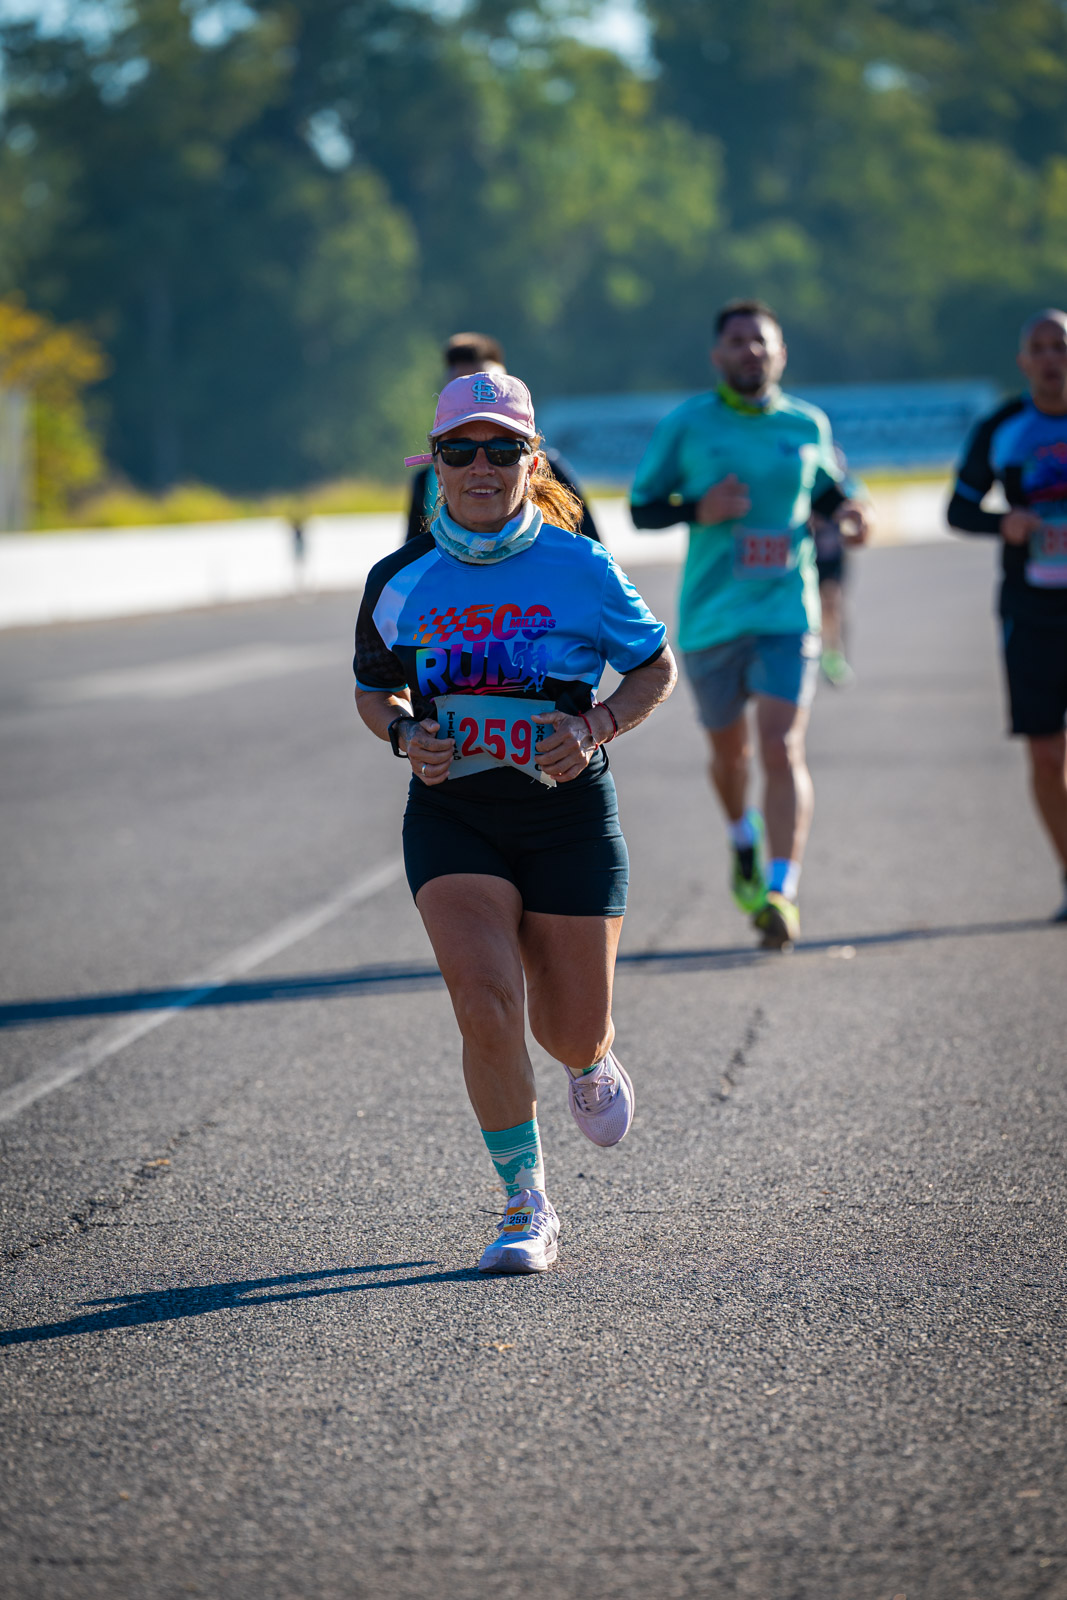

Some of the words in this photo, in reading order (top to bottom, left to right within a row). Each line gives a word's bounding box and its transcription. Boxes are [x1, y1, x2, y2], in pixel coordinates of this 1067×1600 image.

[462, 603, 552, 642] 500
[509, 618, 556, 629] MILLAS
[415, 641, 530, 697] RUN
[458, 717, 532, 765] 259
[509, 1215, 528, 1224] 259
